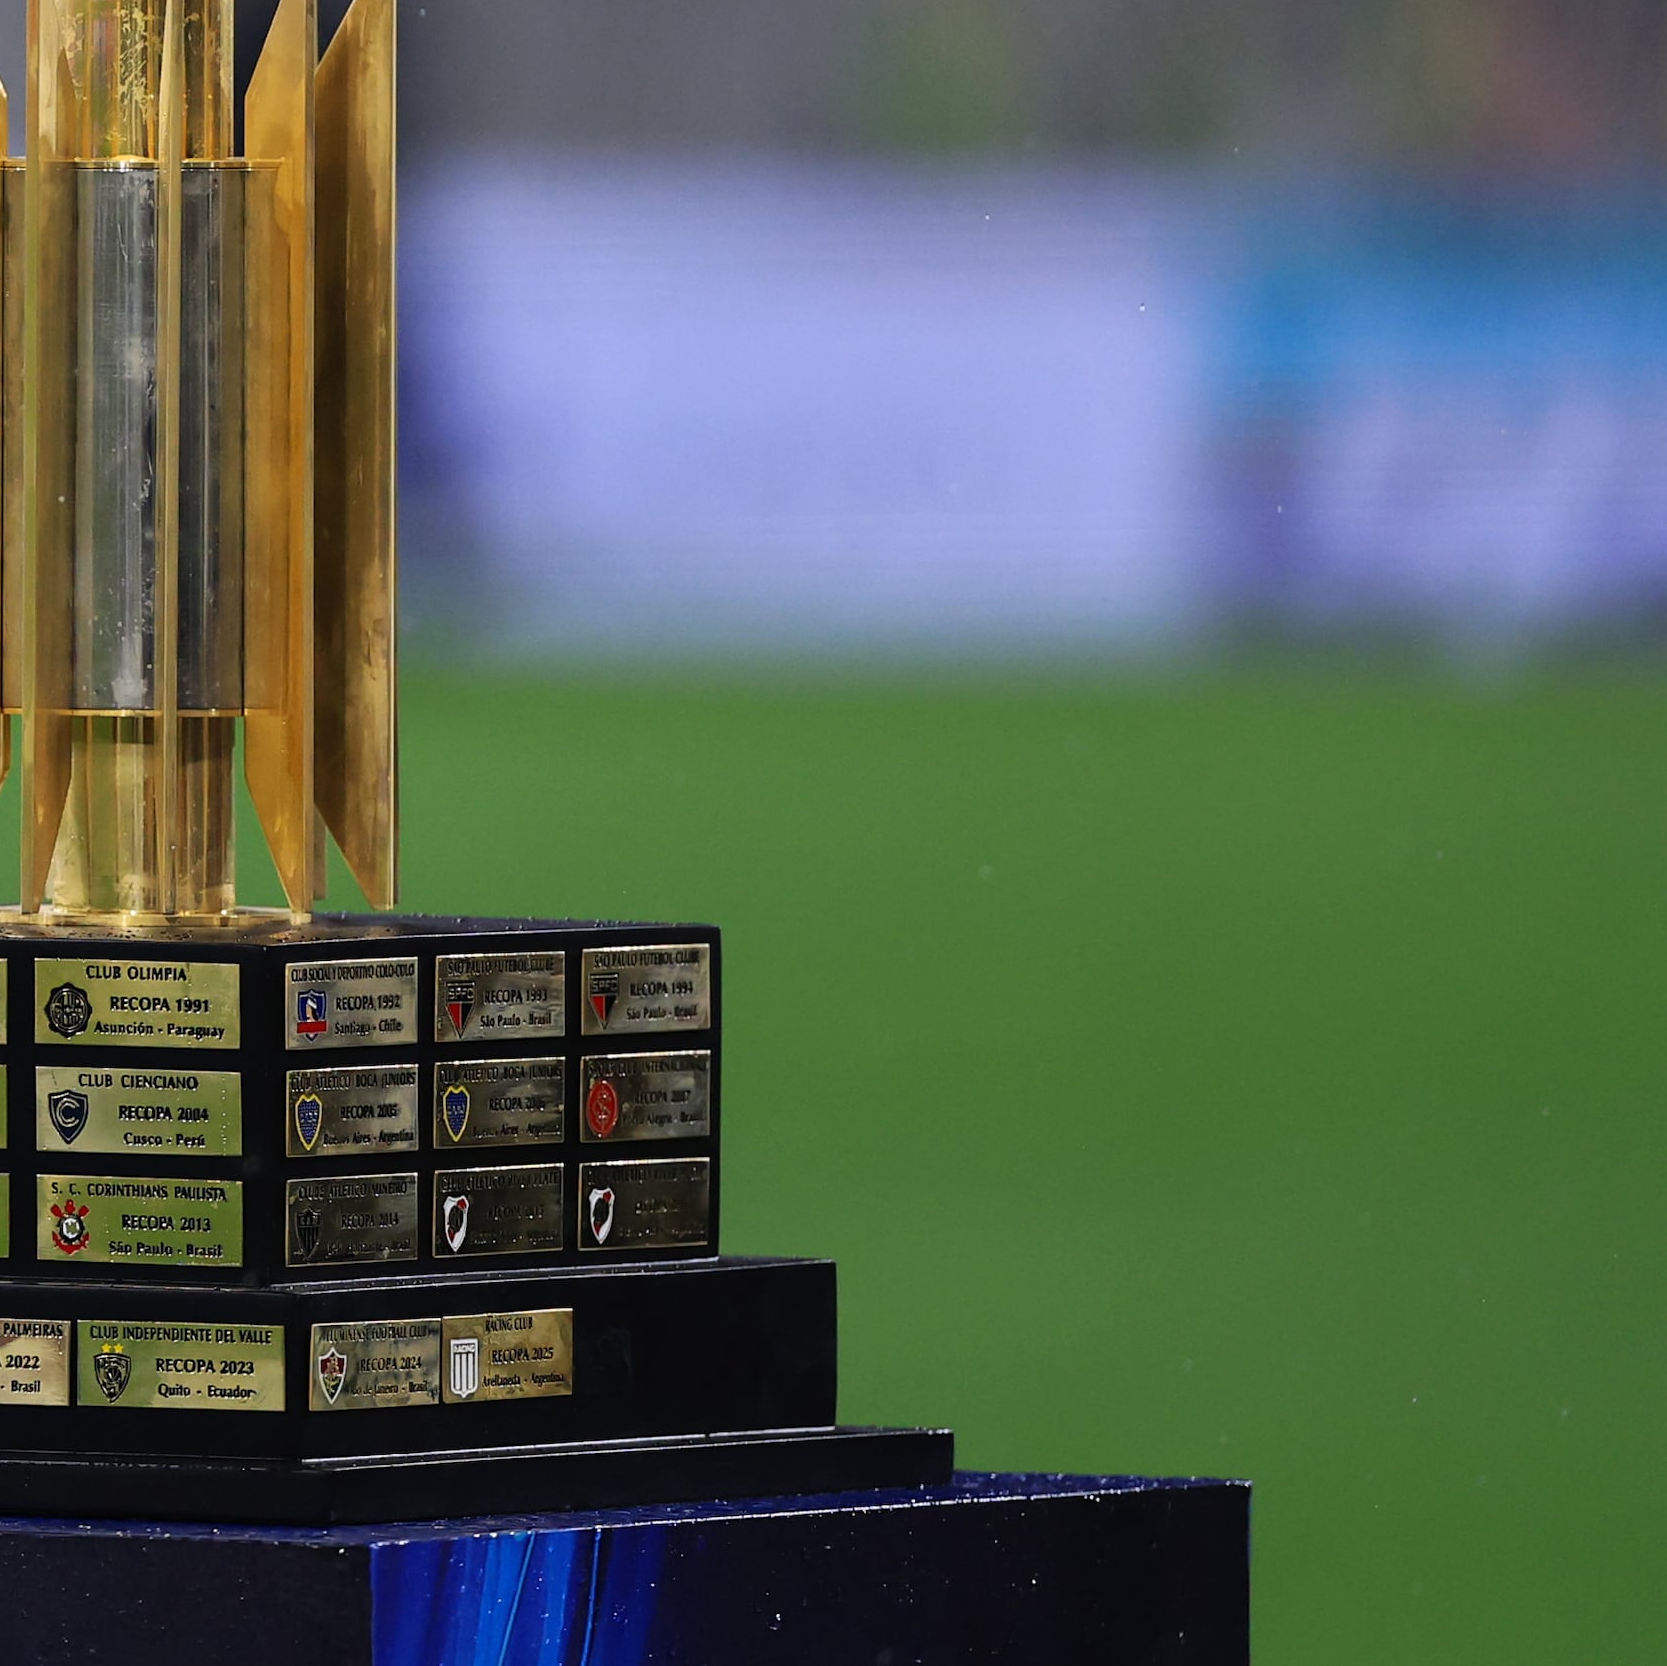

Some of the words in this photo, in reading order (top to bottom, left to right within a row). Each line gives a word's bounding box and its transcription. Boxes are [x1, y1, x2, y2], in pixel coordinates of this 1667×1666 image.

[86, 965, 121, 979] CLUB
[128, 966, 187, 982] OLIMPIA
[292, 968, 308, 982] CLUB
[333, 967, 336, 980] Y
[338, 965, 374, 980] DEPORTIVO
[375, 964, 414, 978] COLO-COLO
[484, 989, 523, 1004] RECOPA
[526, 989, 548, 1002] 1993
[630, 982, 668, 996] RECOPA
[110, 996, 170, 1011] RECOPA
[176, 998, 210, 1013] 1991
[336, 996, 374, 1010] RECOPA
[378, 995, 401, 1009] 1992
[335, 1021, 370, 1036] Santiago
[379, 1018, 402, 1032] Chile
[498, 1013, 521, 1026] Paulo
[529, 1012, 551, 1025] Brasil
[94, 1022, 153, 1034] Asunción
[168, 1023, 225, 1039] Paraguay
[79, 1073, 112, 1087] CLUB
[121, 1075, 199, 1090] CIENCIANO
[119, 1105, 172, 1120] RECOPA
[178, 1107, 208, 1121] 2004
[341, 1104, 374, 1118] RECOPA
[124, 1133, 162, 1146] Cusco
[176, 1134, 205, 1146] Perú
[52, 1182, 63, 1194] S.
[70, 1183, 81, 1195] C.
[88, 1183, 167, 1198] CORINTHIANS
[175, 1186, 227, 1201] PAULISTA
[122, 1214, 173, 1230] RECOPA
[180, 1217, 211, 1231] 2013
[109, 1241, 131, 1255] São
[137, 1242, 172, 1255] Paulo
[186, 1244, 223, 1257] Brasil
[4, 1323, 62, 1337] PALMEIRAS
[514, 1316, 533, 1330] CLUB
[91, 1326, 118, 1339] CLUB
[123, 1327, 212, 1342] INDEPENDIENTE
[217, 1329, 235, 1342] DEL
[239, 1330, 272, 1344] VALLE
[6, 1355, 40, 1369] 2022
[492, 1348, 529, 1363] RECOPA
[532, 1347, 554, 1360] 2025
[156, 1358, 216, 1373] RECOPA
[220, 1361, 254, 1374] 2023
[360, 1358, 397, 1372] RECOPA
[401, 1356, 422, 1369] 2024
[11, 1380, 40, 1393] Brasil
[531, 1372, 564, 1387] Argentina
[158, 1384, 190, 1397] Quito
[208, 1385, 257, 1398] Ecuador
